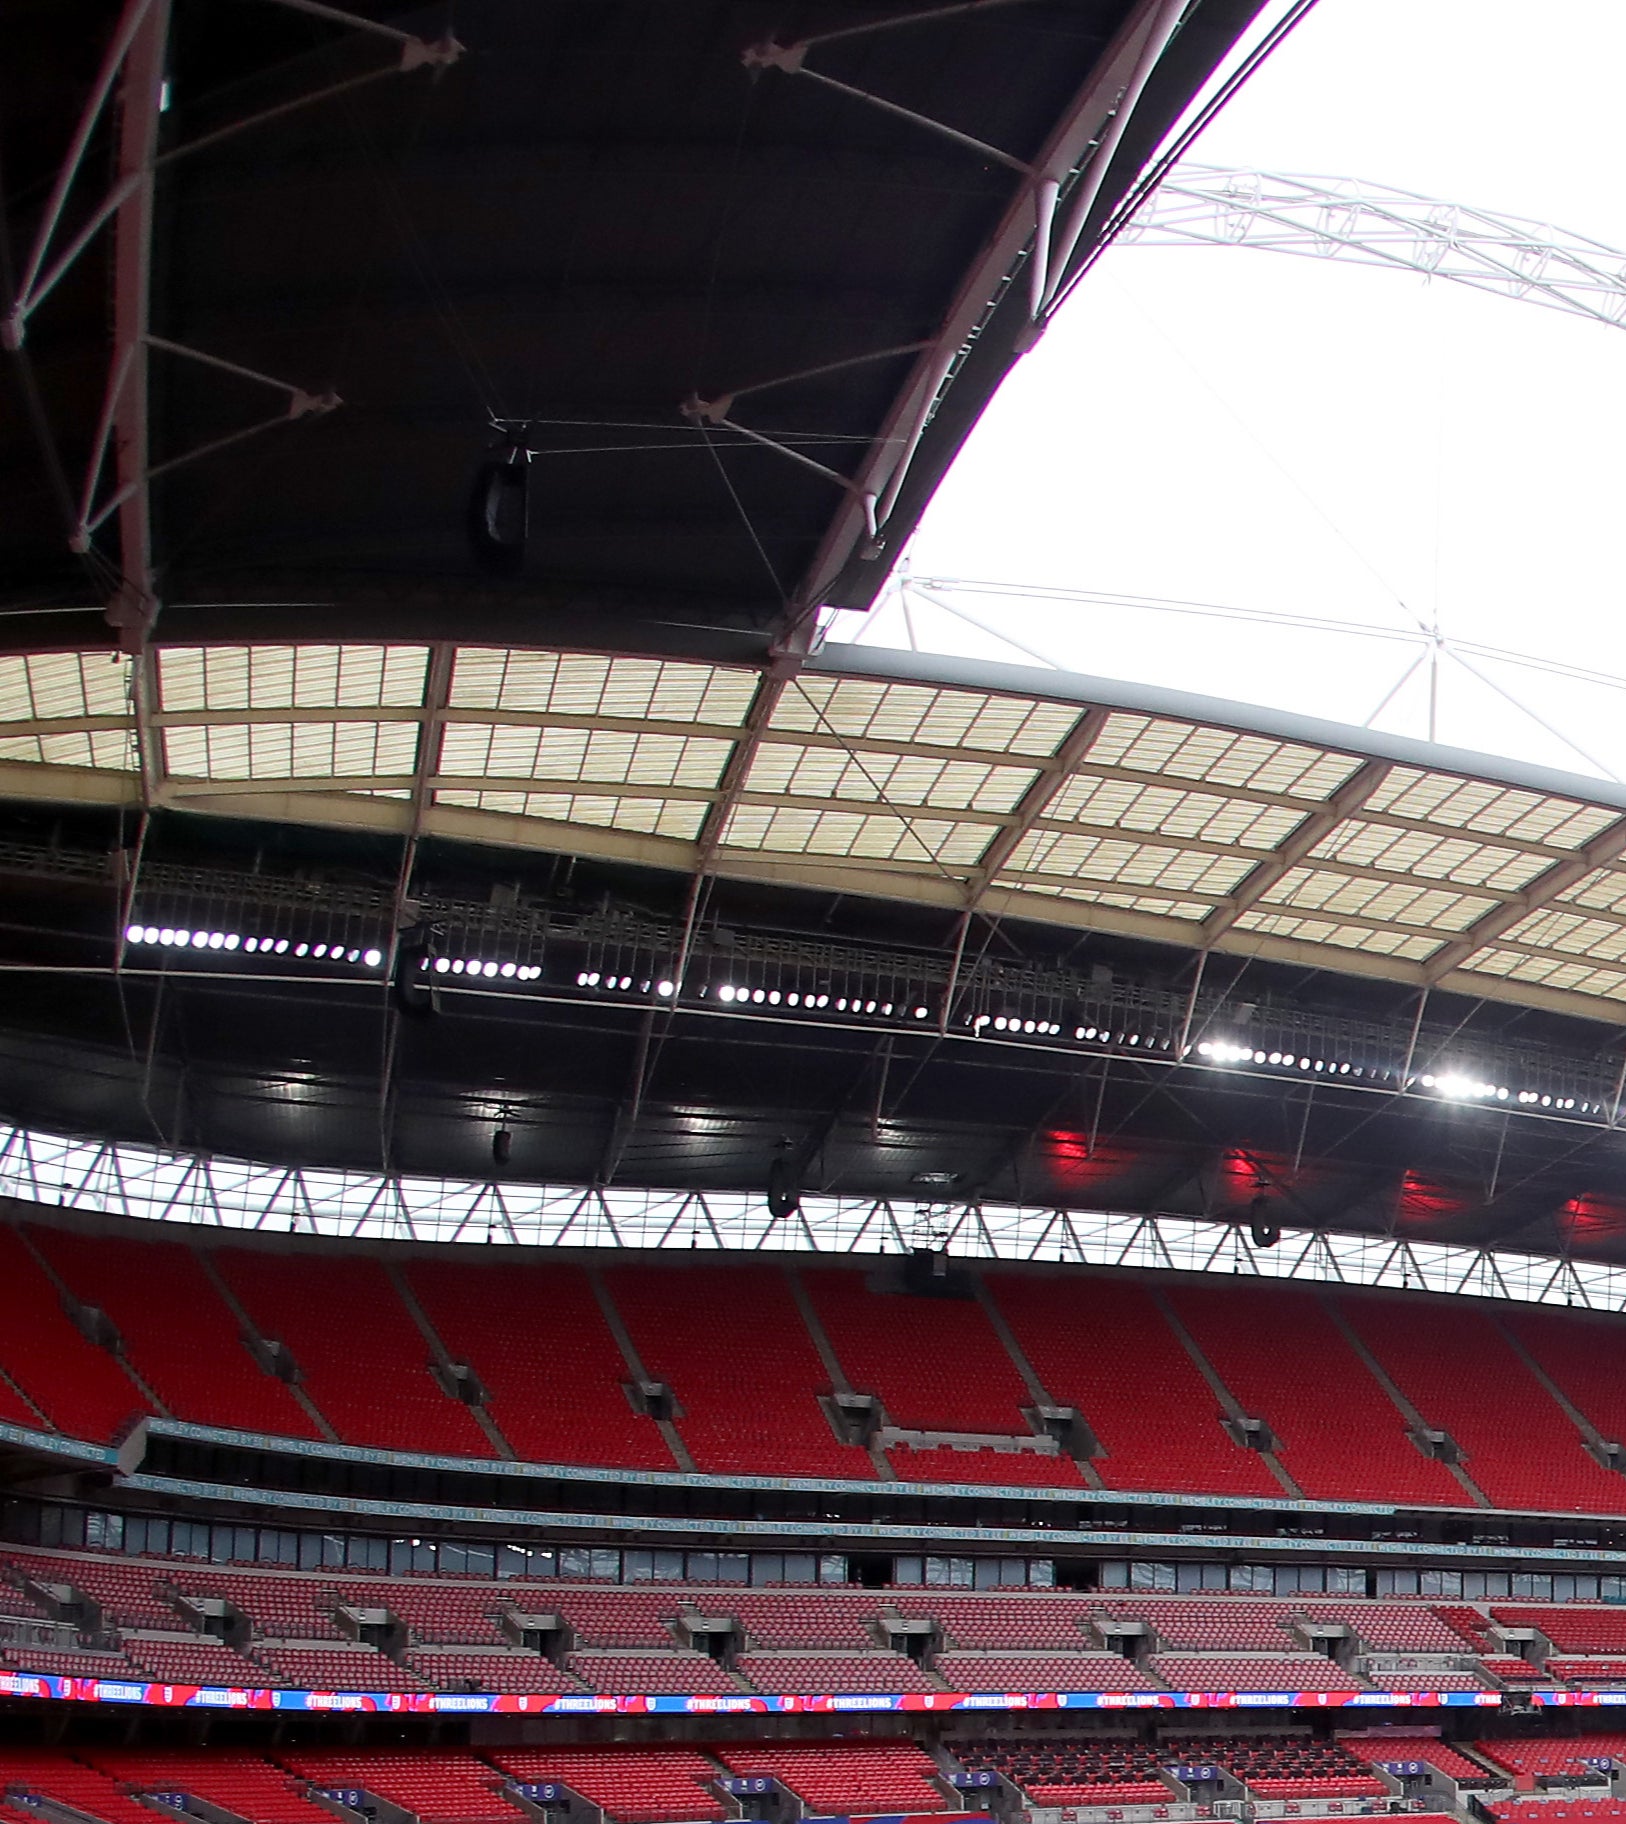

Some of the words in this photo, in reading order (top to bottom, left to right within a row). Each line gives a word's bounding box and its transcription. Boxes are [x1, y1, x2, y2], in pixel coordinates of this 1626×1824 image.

[94, 1683, 141, 1701] #THREELIONS
[196, 1690, 247, 1705] #THREELIONS
[306, 1694, 361, 1709] #THREELIONS
[429, 1697, 488, 1710] #THREELIONS
[554, 1697, 616, 1710] #THREELIONS
[687, 1697, 751, 1710] #THREELIONS
[826, 1696, 892, 1709] #THREELIONS
[964, 1696, 1027, 1708] #THREELIONS
[1097, 1695, 1160, 1708] #THREELIONS
[1230, 1694, 1289, 1706] #THREELIONS
[1354, 1694, 1411, 1705] #THREELIONS
